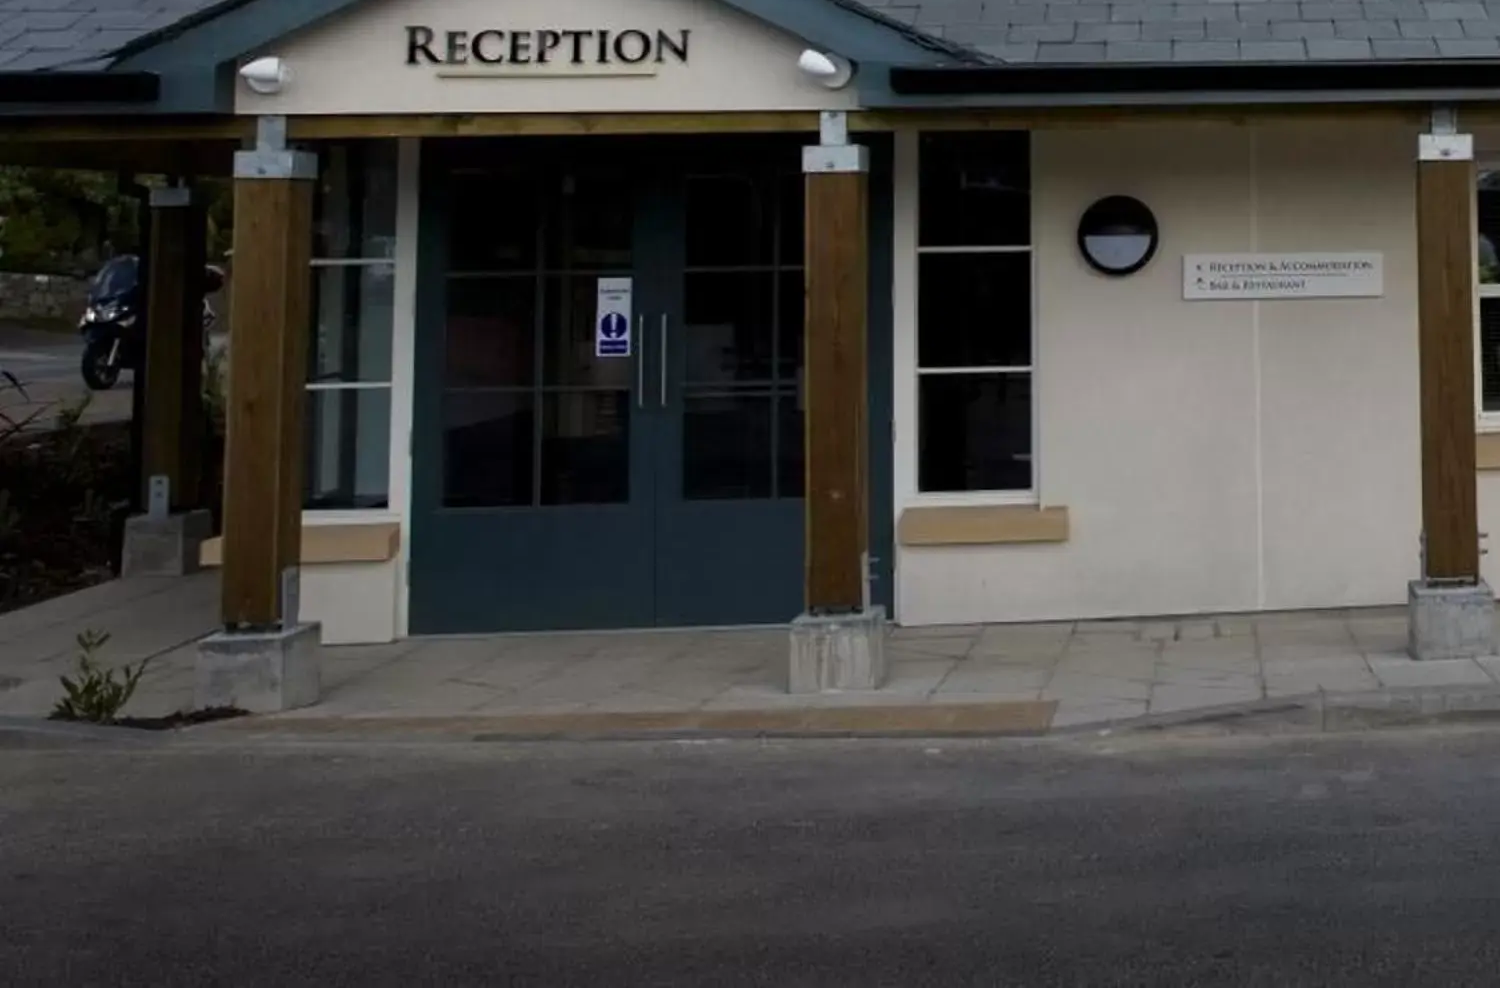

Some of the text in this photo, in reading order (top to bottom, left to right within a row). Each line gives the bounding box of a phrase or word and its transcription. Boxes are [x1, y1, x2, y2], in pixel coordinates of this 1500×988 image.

[404, 25, 692, 65] RECEPTION
[1209, 261, 1265, 272] RECEPTION
[1281, 259, 1374, 271] ACCOMMODATION
[1243, 278, 1306, 290] RESTAURANT
